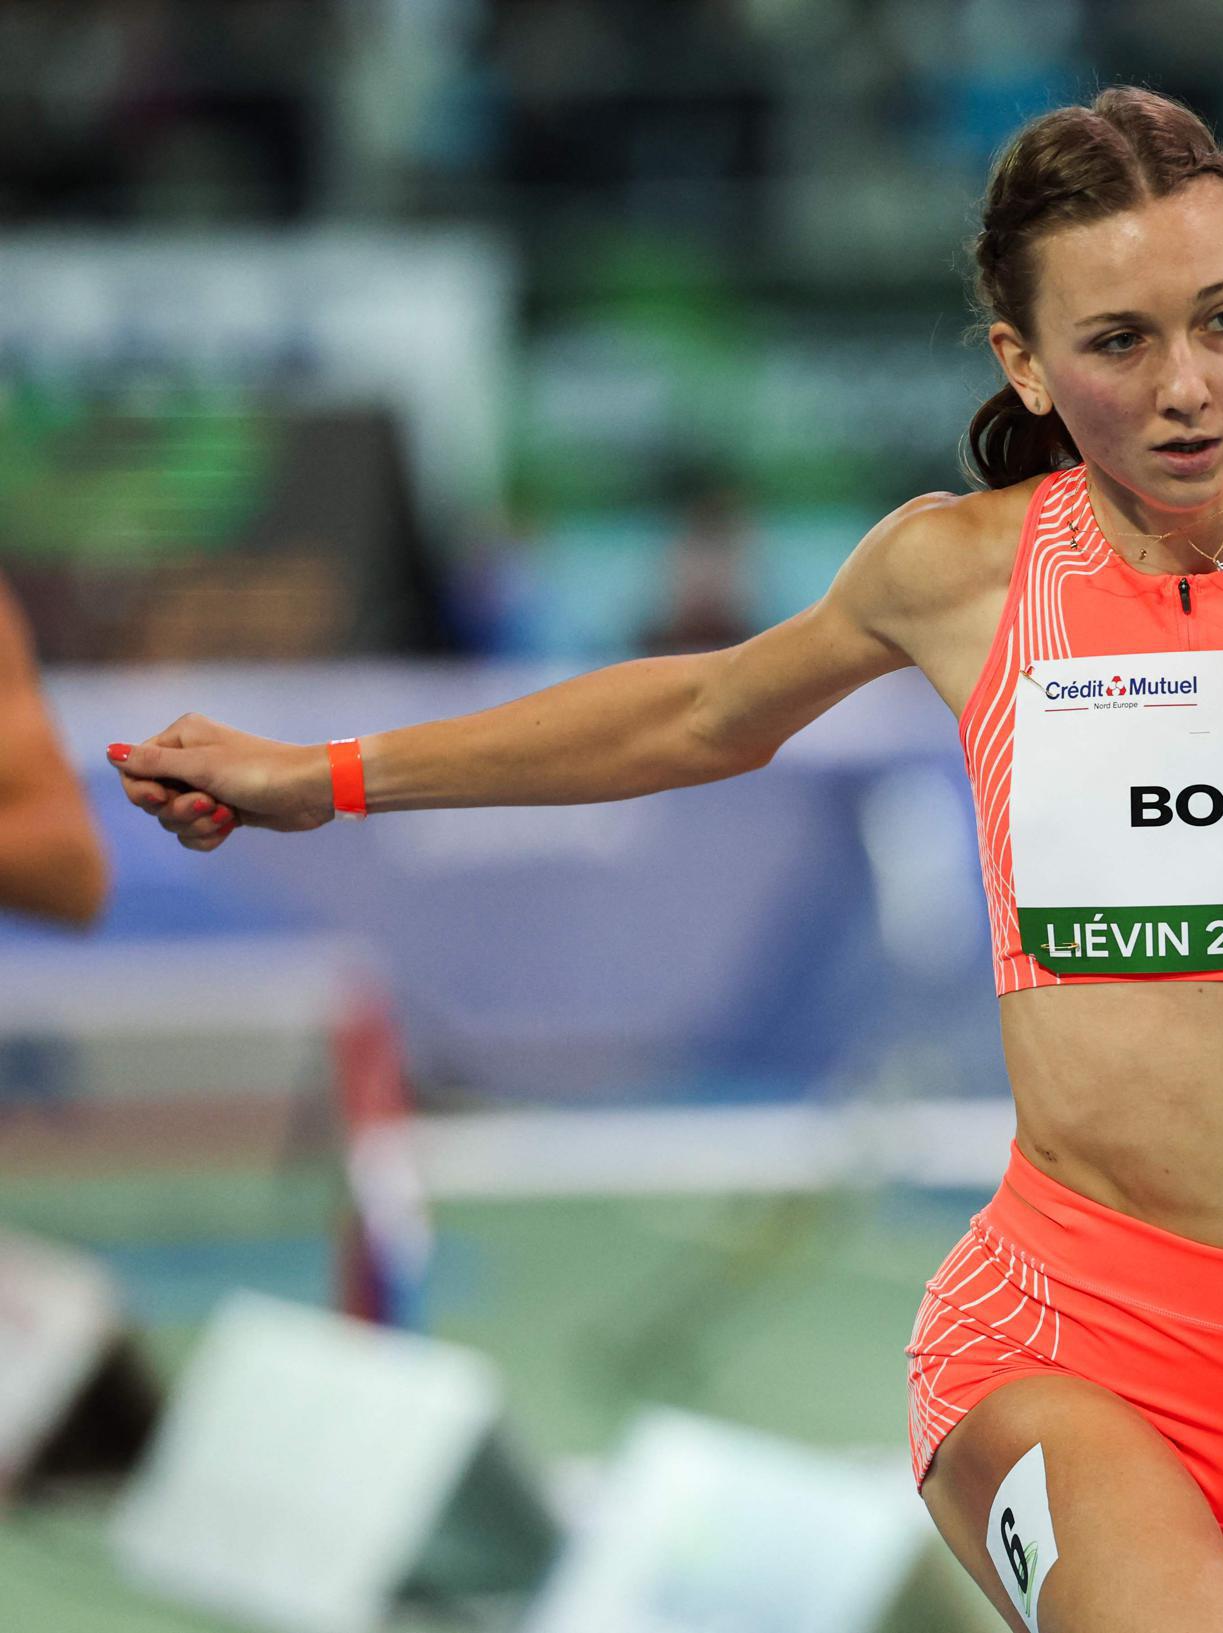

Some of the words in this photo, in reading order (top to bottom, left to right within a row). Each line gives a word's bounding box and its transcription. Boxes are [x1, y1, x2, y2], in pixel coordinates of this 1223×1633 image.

[1045, 680, 1104, 700] Crédit
[1129, 676, 1198, 695] Mutuel
[1094, 702, 1111, 710] Nord
[1112, 702, 1139, 710] Europe
[1046, 913, 1190, 958] LIÉVIN
[1001, 1507, 1029, 1594] 6
